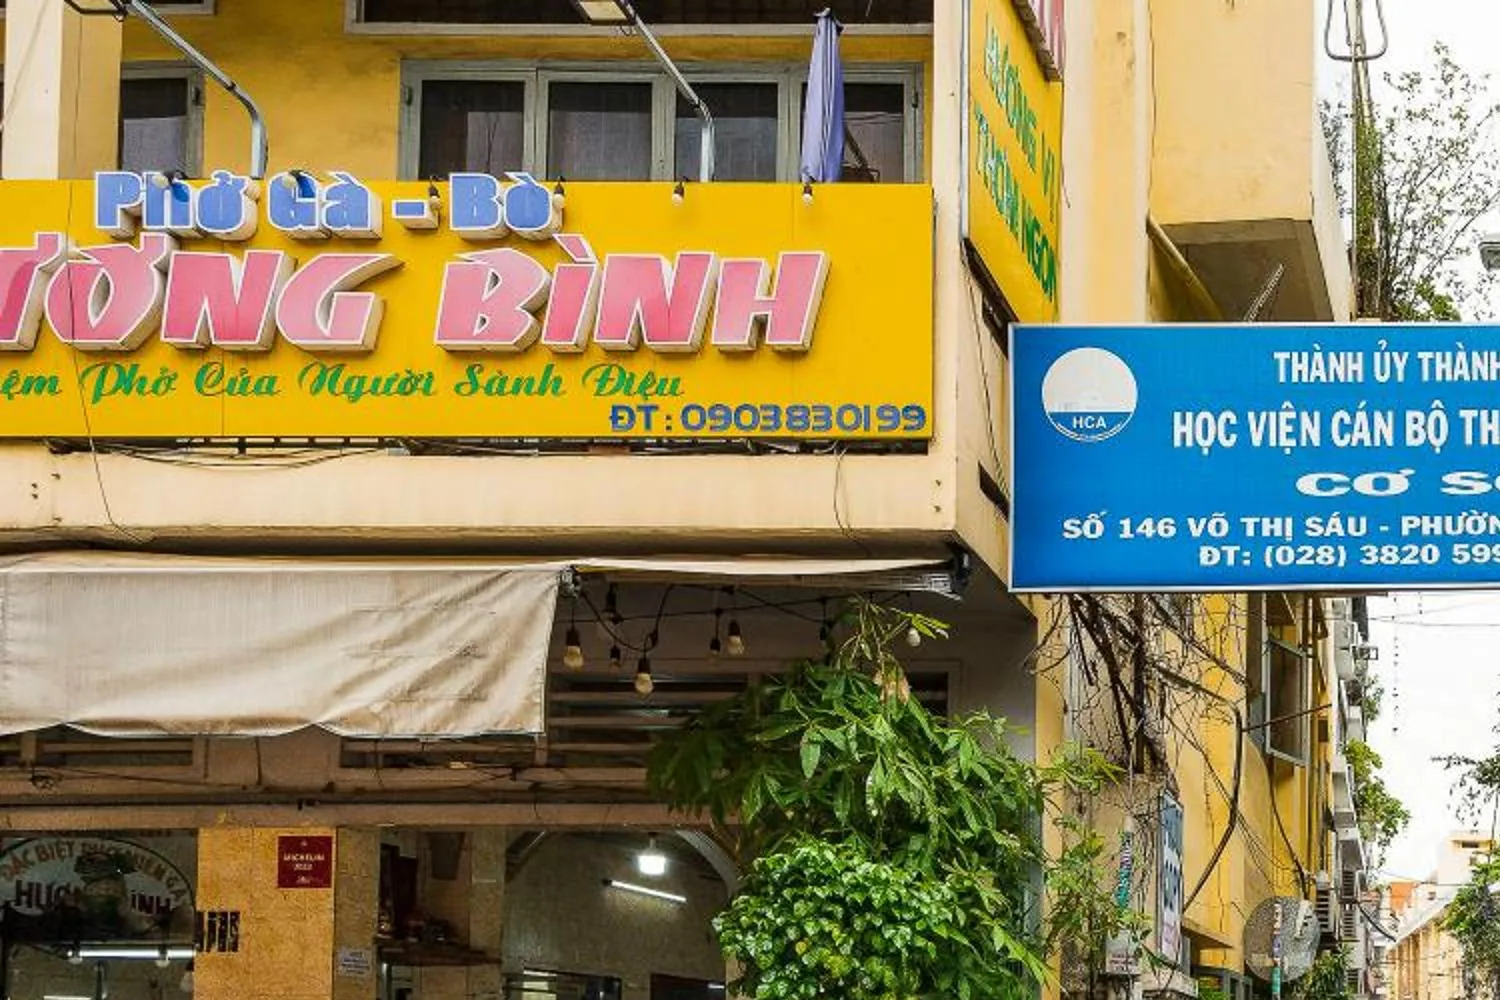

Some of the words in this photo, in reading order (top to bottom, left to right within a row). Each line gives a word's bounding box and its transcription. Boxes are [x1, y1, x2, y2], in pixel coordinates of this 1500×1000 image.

[95, 171, 258, 241] Phở
[267, 172, 383, 240] Gà
[449, 172, 562, 240] Bò
[434, 234, 830, 352] BÌNH
[1273, 343, 1364, 384] THÀNH
[1373, 339, 1409, 383] ỦY
[80, 361, 179, 405] Phở
[194, 361, 281, 397] Của
[298, 362, 437, 402] Người
[454, 362, 567, 397] Sành
[582, 363, 686, 402] Điệu
[681, 403, 927, 432] 0903830199
[1072, 415, 1107, 429] HCA
[1173, 410, 1237, 456] HỌC
[1247, 402, 1321, 455] VIỆN
[1331, 401, 1394, 448] CÁN
[1405, 400, 1449, 454] BỘ
[1295, 468, 1415, 497] CƠ
[1063, 511, 1107, 539] SỐ
[1119, 517, 1177, 539] 146
[1187, 512, 1229, 538] VÕ
[1240, 517, 1293, 541] THỊ
[1305, 512, 1367, 537] SÁU
[1199, 545, 1251, 567] ĐT:
[1264, 544, 1347, 567] (028)
[1360, 544, 1441, 565] 3820
